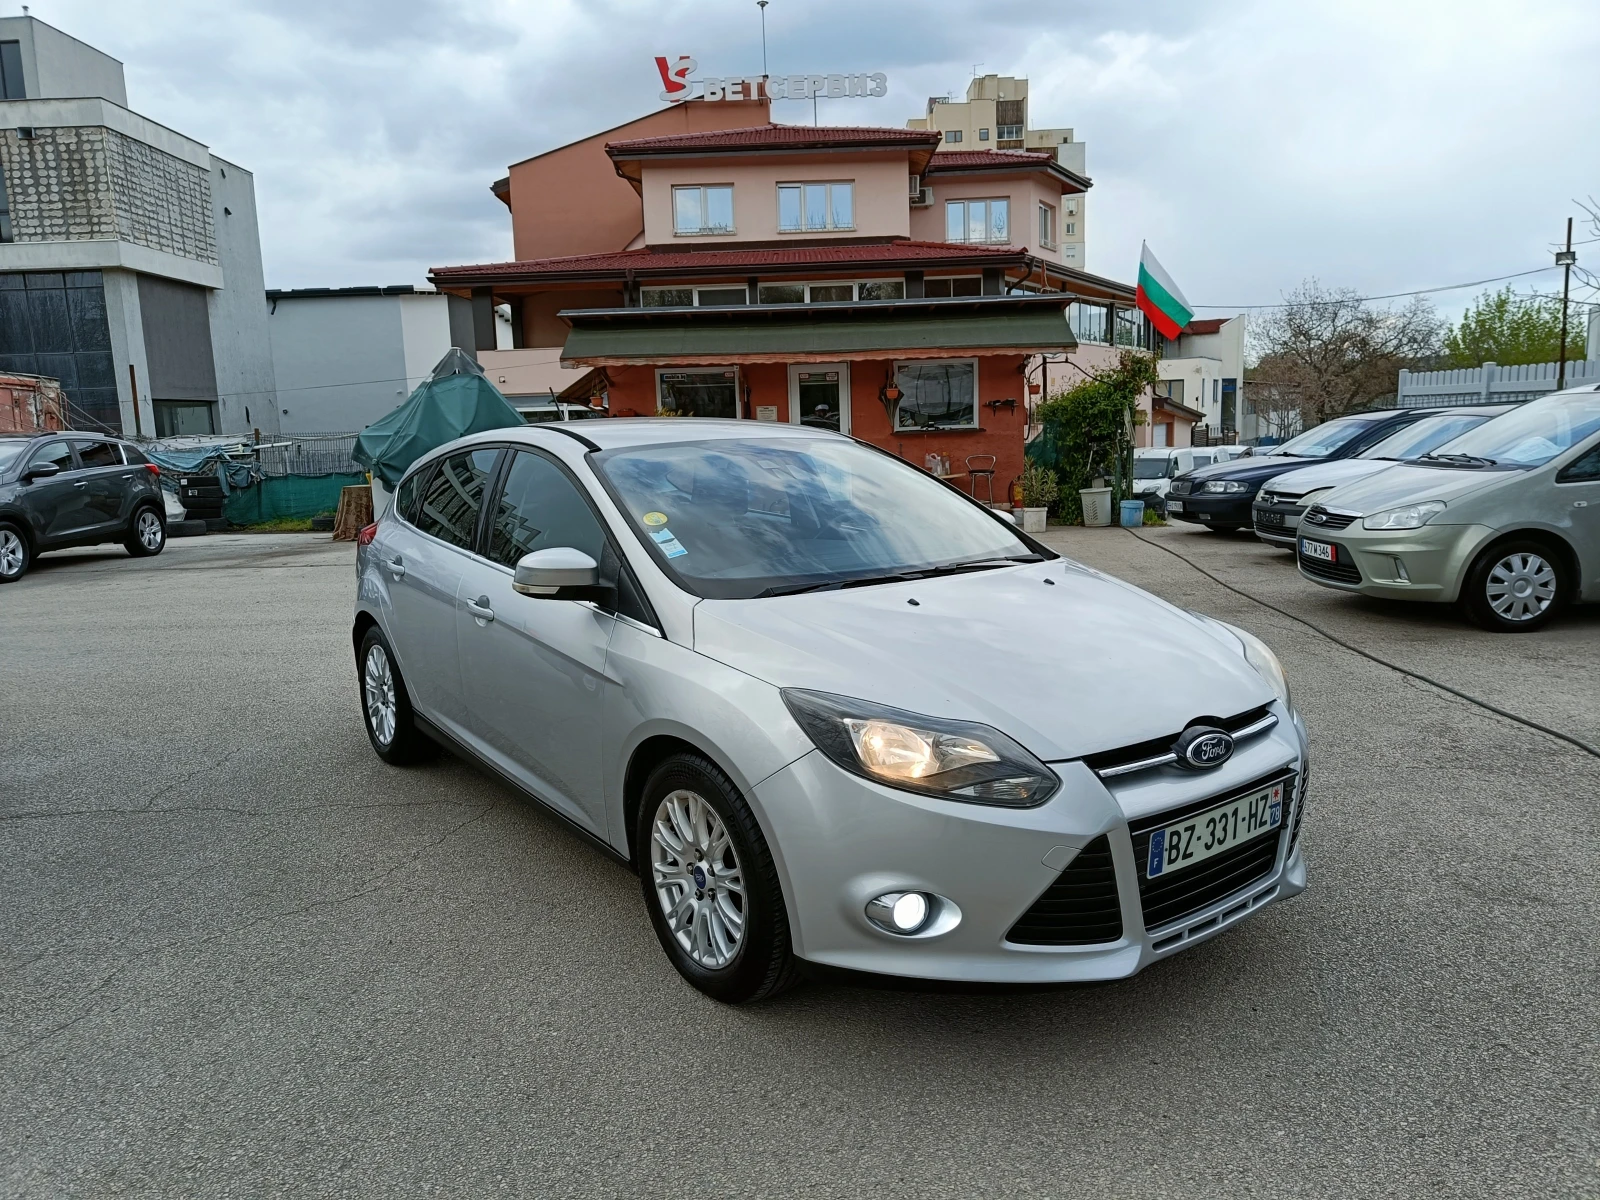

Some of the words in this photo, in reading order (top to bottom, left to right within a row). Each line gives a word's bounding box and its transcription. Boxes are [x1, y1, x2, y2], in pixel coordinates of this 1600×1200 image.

[1201, 738, 1226, 760] Ford
[1167, 793, 1270, 866] BZ-331-HZ
[1153, 857, 1160, 869] F
